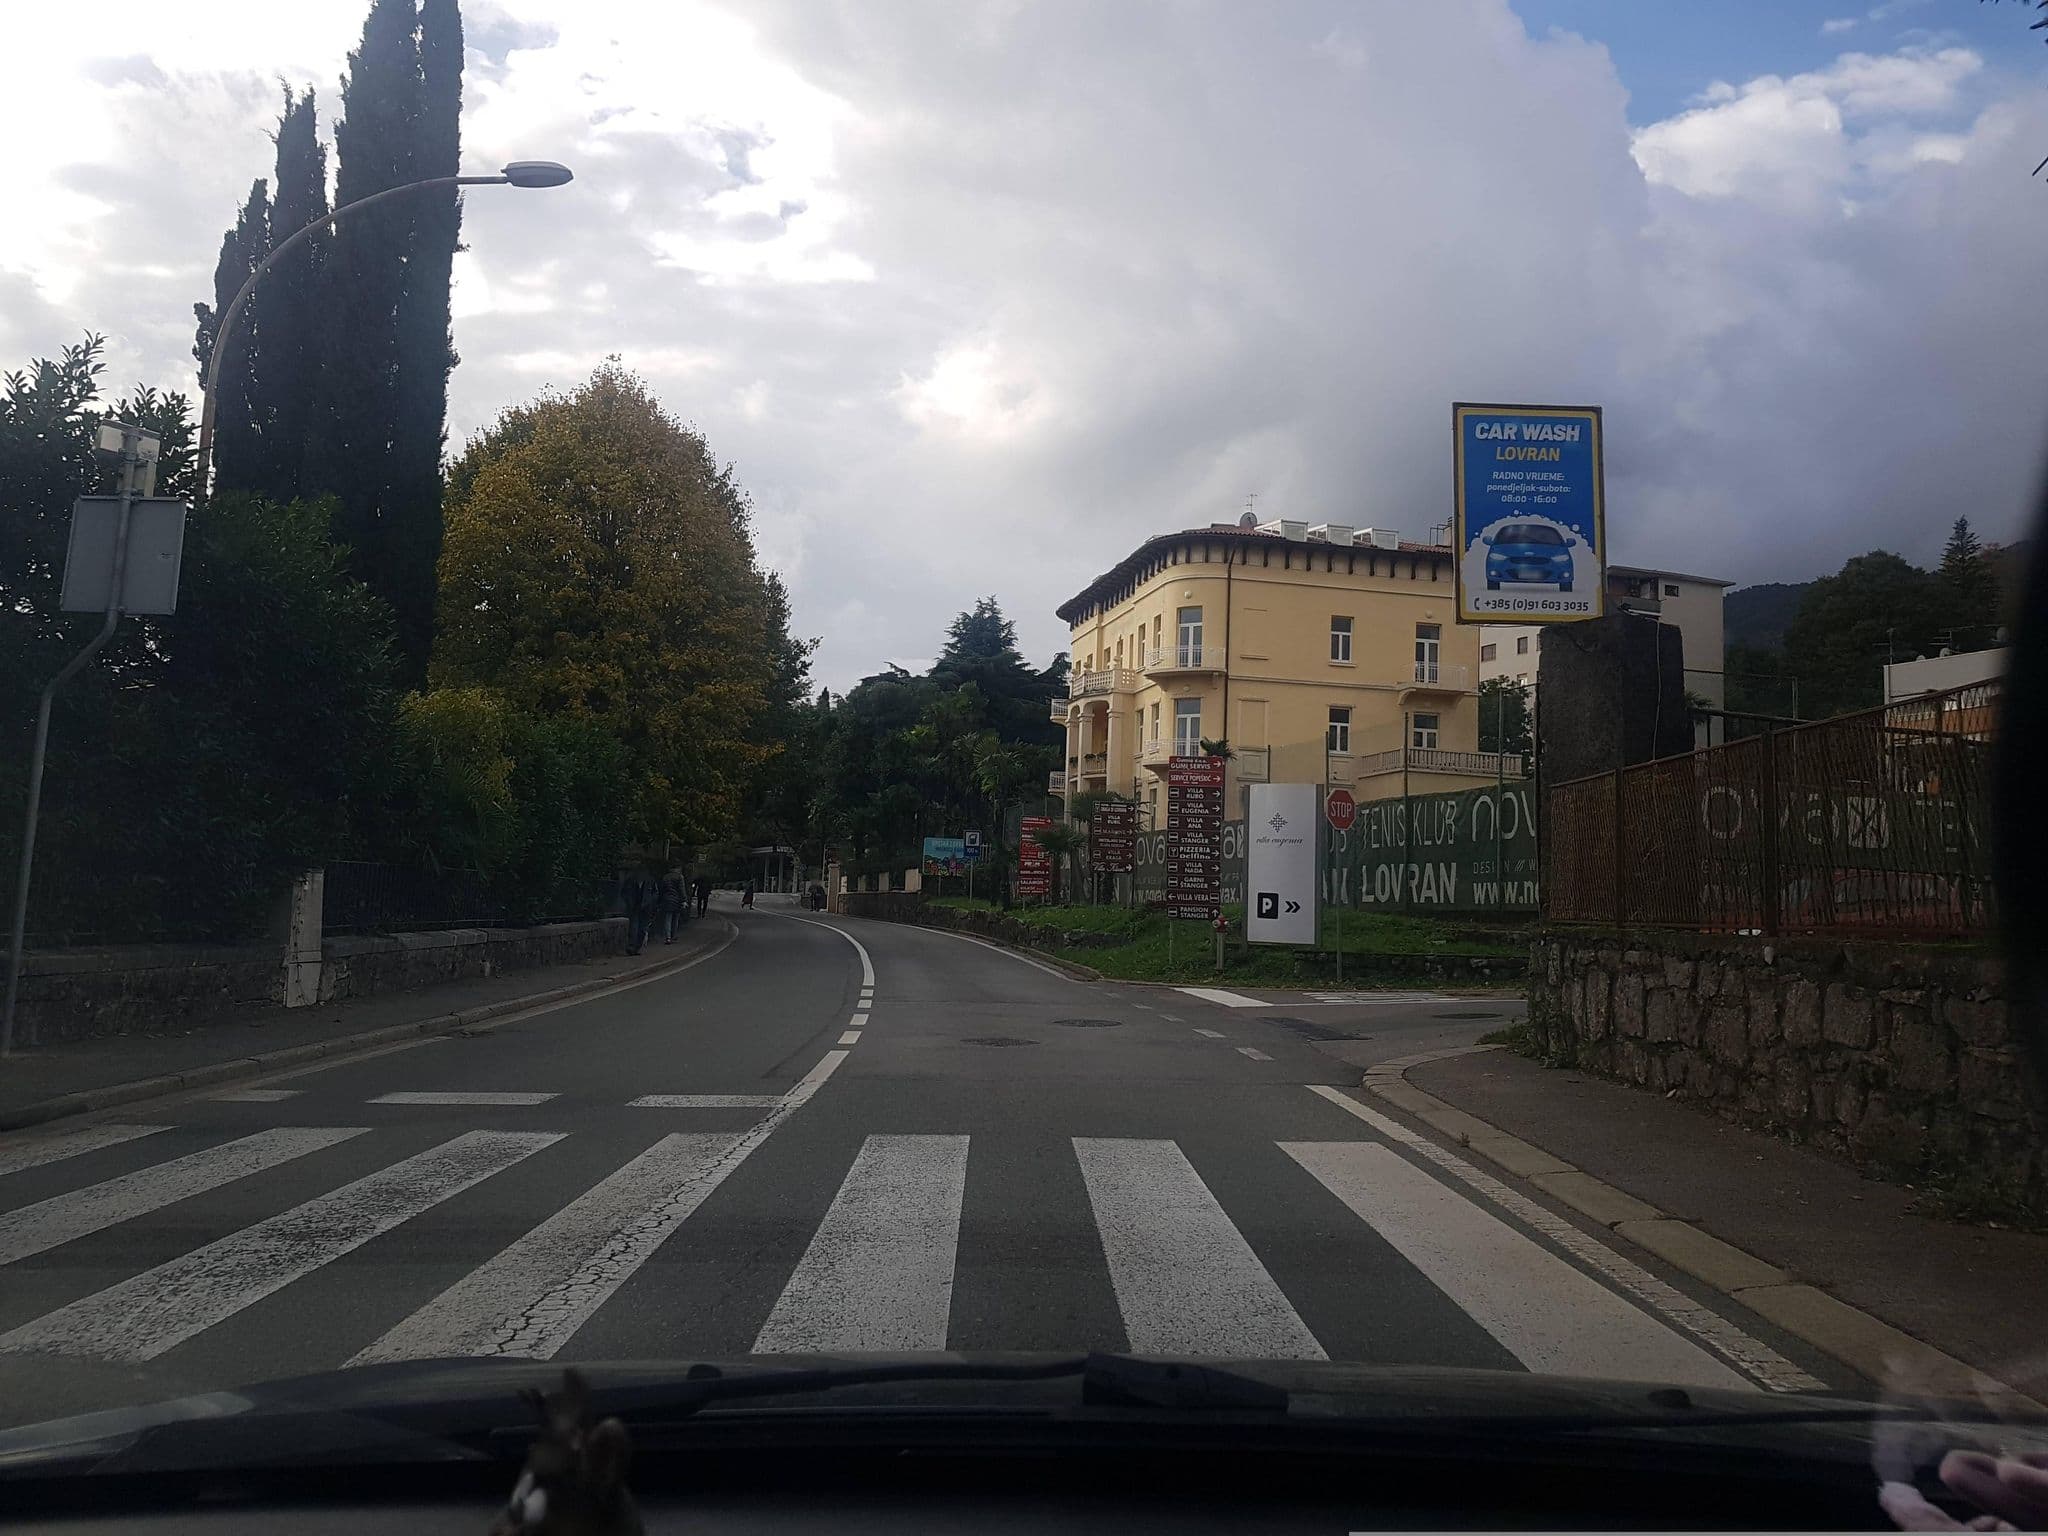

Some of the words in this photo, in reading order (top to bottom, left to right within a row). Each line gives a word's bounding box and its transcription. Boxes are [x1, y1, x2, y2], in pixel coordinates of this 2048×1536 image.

[1475, 422, 1517, 440] CAR
[1522, 423, 1581, 442] WASH
[1495, 446, 1561, 462] LOVRAN
[1492, 471, 1524, 480] RADNO
[1501, 494, 1527, 504] 08:00
[1533, 495, 1558, 504] 16:00
[1484, 599, 1511, 610] +385
[1513, 599, 1539, 611] (0)91
[1541, 600, 1561, 610] 603
[1563, 601, 1590, 612] 3035
[1330, 801, 1352, 818] STOP
[1361, 805, 1406, 850] TENIS
[1413, 800, 1456, 846] KLUB
[1361, 862, 1457, 905] LOVRAN
[1176, 893, 1193, 901] VILLA
[1193, 893, 1209, 901] VERA
